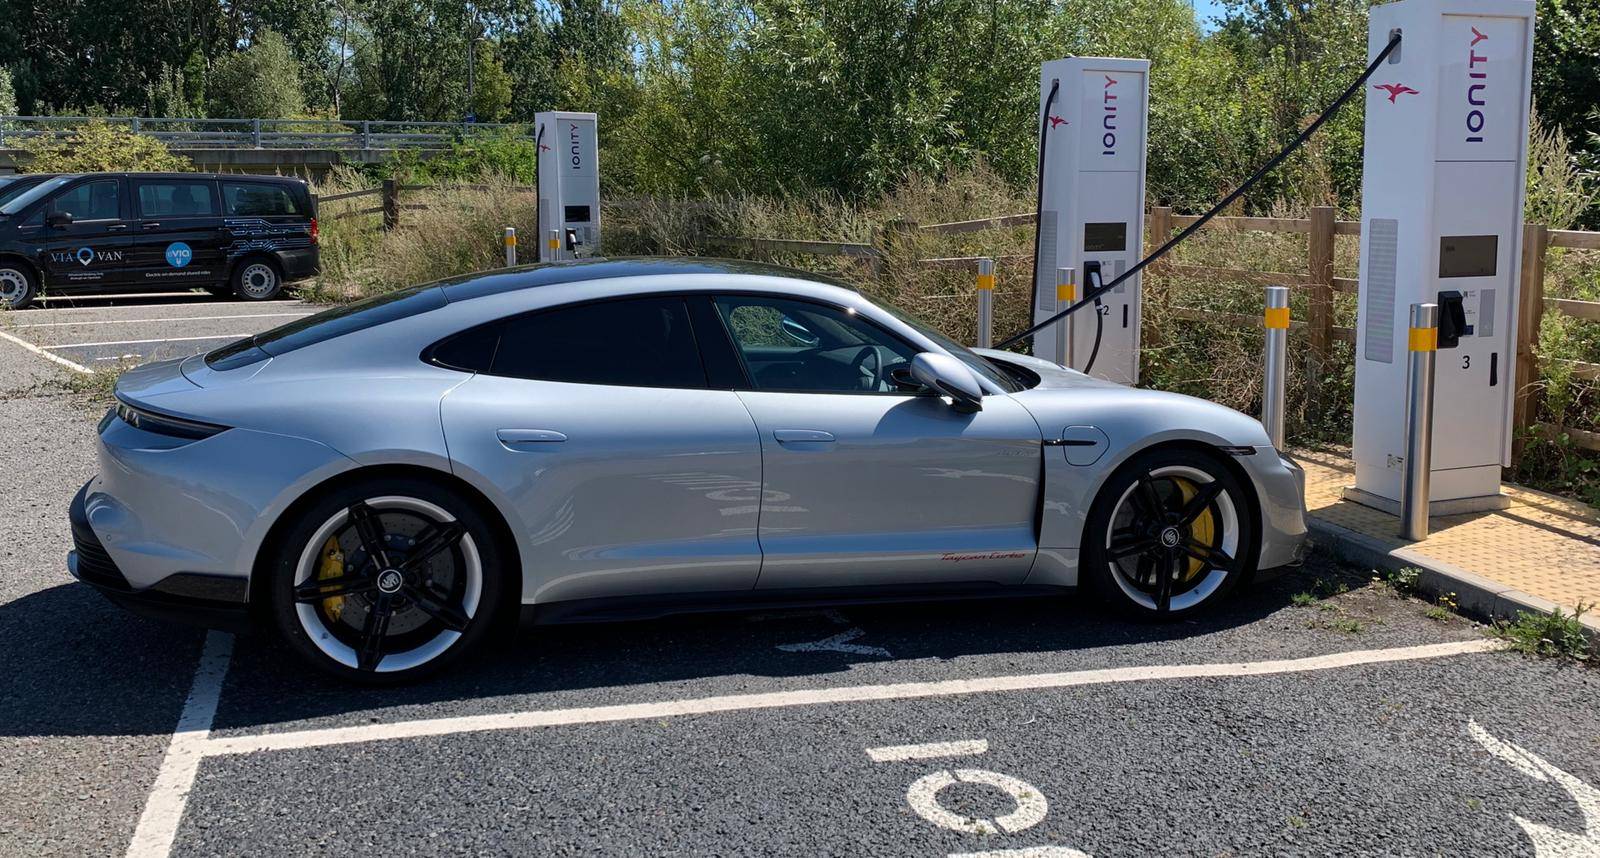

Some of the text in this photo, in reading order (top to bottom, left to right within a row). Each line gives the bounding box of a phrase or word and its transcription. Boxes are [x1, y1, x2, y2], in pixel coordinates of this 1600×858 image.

[1466, 26, 1488, 142] IONITY
[1102, 75, 1118, 156] IONITY
[571, 124, 581, 169] IONITY
[50, 250, 122, 262] VIA VAN
[1103, 304, 1110, 316] 2
[1462, 355, 1470, 370] 3
